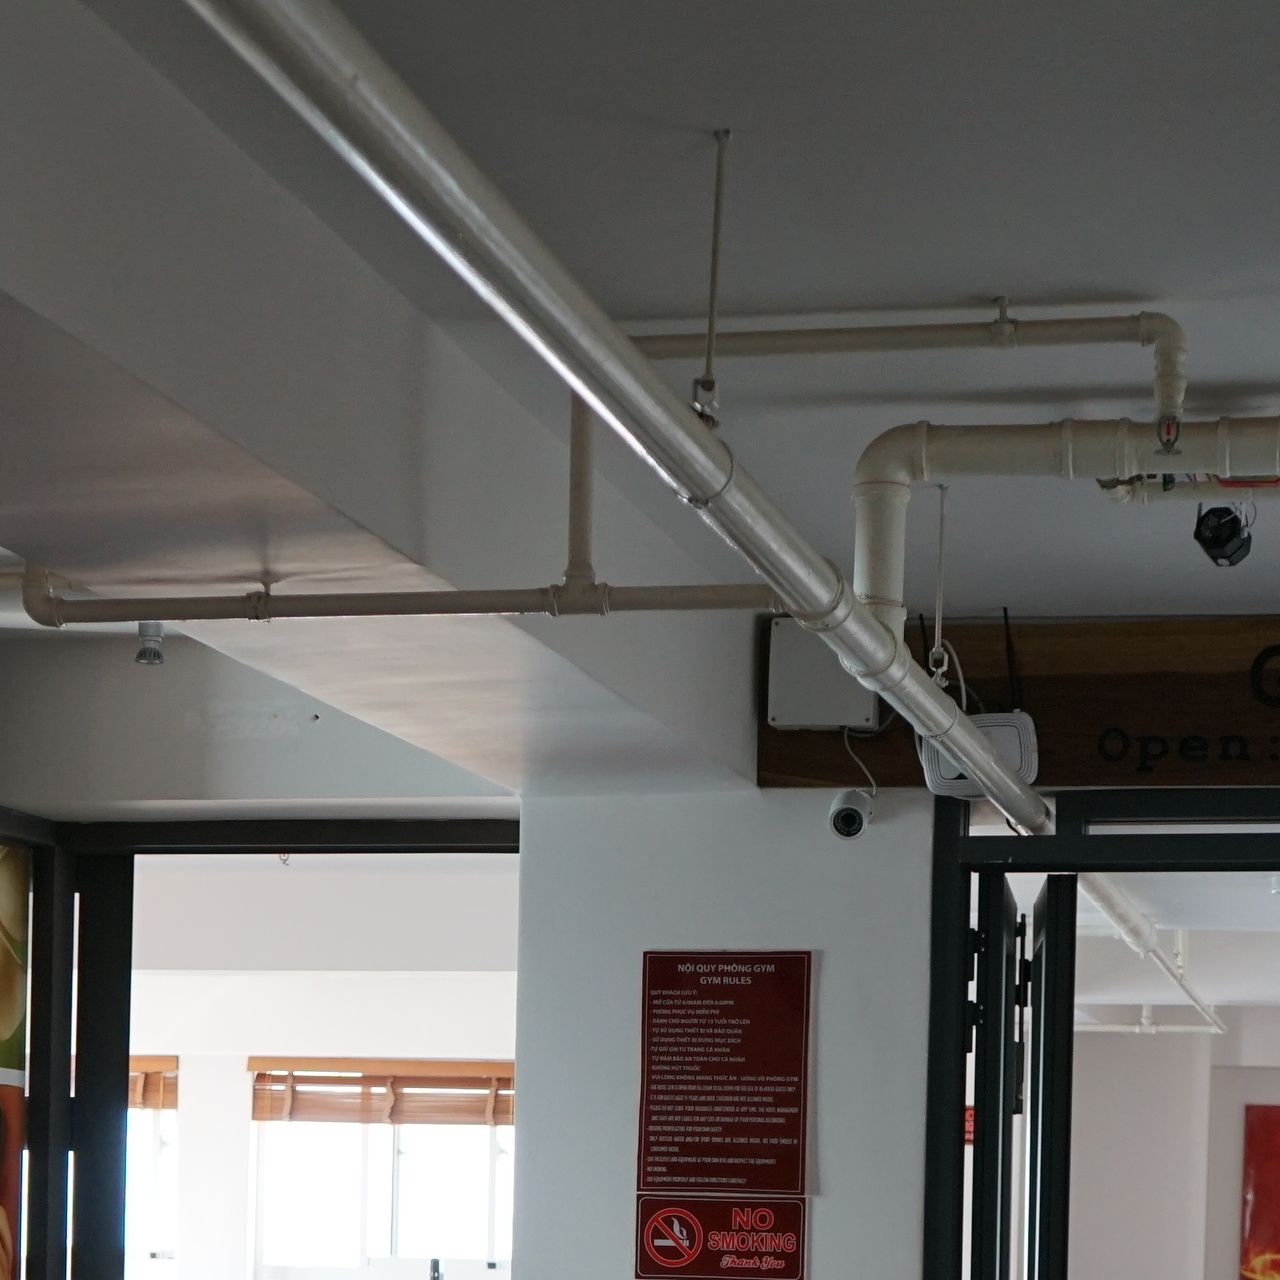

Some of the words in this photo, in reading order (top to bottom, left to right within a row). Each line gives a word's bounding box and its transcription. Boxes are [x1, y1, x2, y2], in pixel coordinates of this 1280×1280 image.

[1097, 727, 1280, 771] Open:
[696, 964, 717, 973] QUY
[753, 964, 775, 973] GYM
[699, 976, 721, 985] GYM
[723, 976, 752, 985] RULES
[731, 1207, 775, 1230] NO
[708, 1231, 797, 1253] SMOKING
[721, 1254, 760, 1269] Thank
[760, 1255, 786, 1270] You
